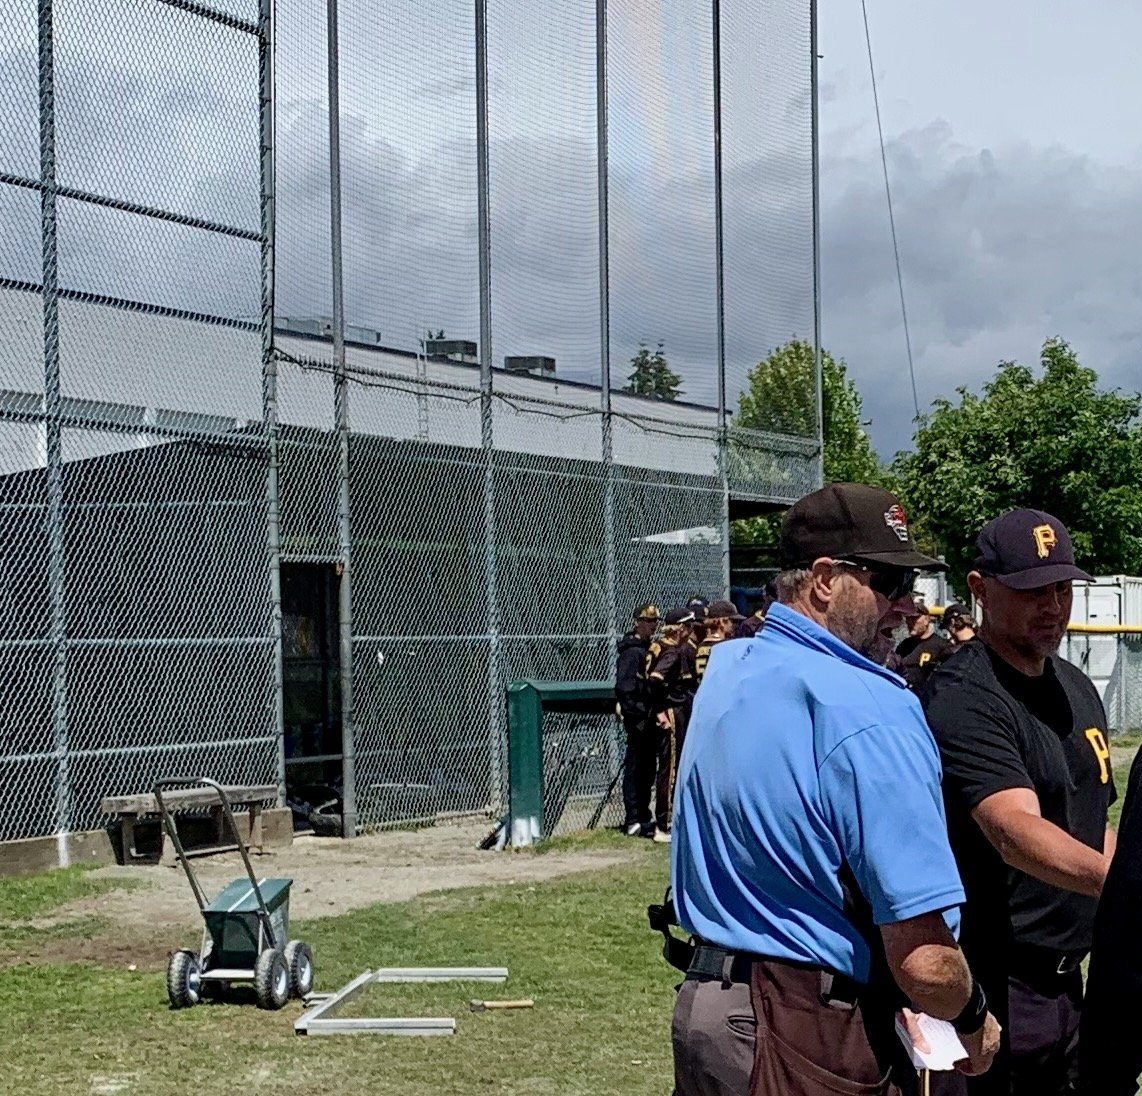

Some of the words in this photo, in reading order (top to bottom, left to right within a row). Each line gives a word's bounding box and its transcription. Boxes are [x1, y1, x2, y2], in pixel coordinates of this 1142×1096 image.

[1033, 523, 1058, 558] P
[919, 652, 931, 667] P
[1085, 728, 1109, 784] P
